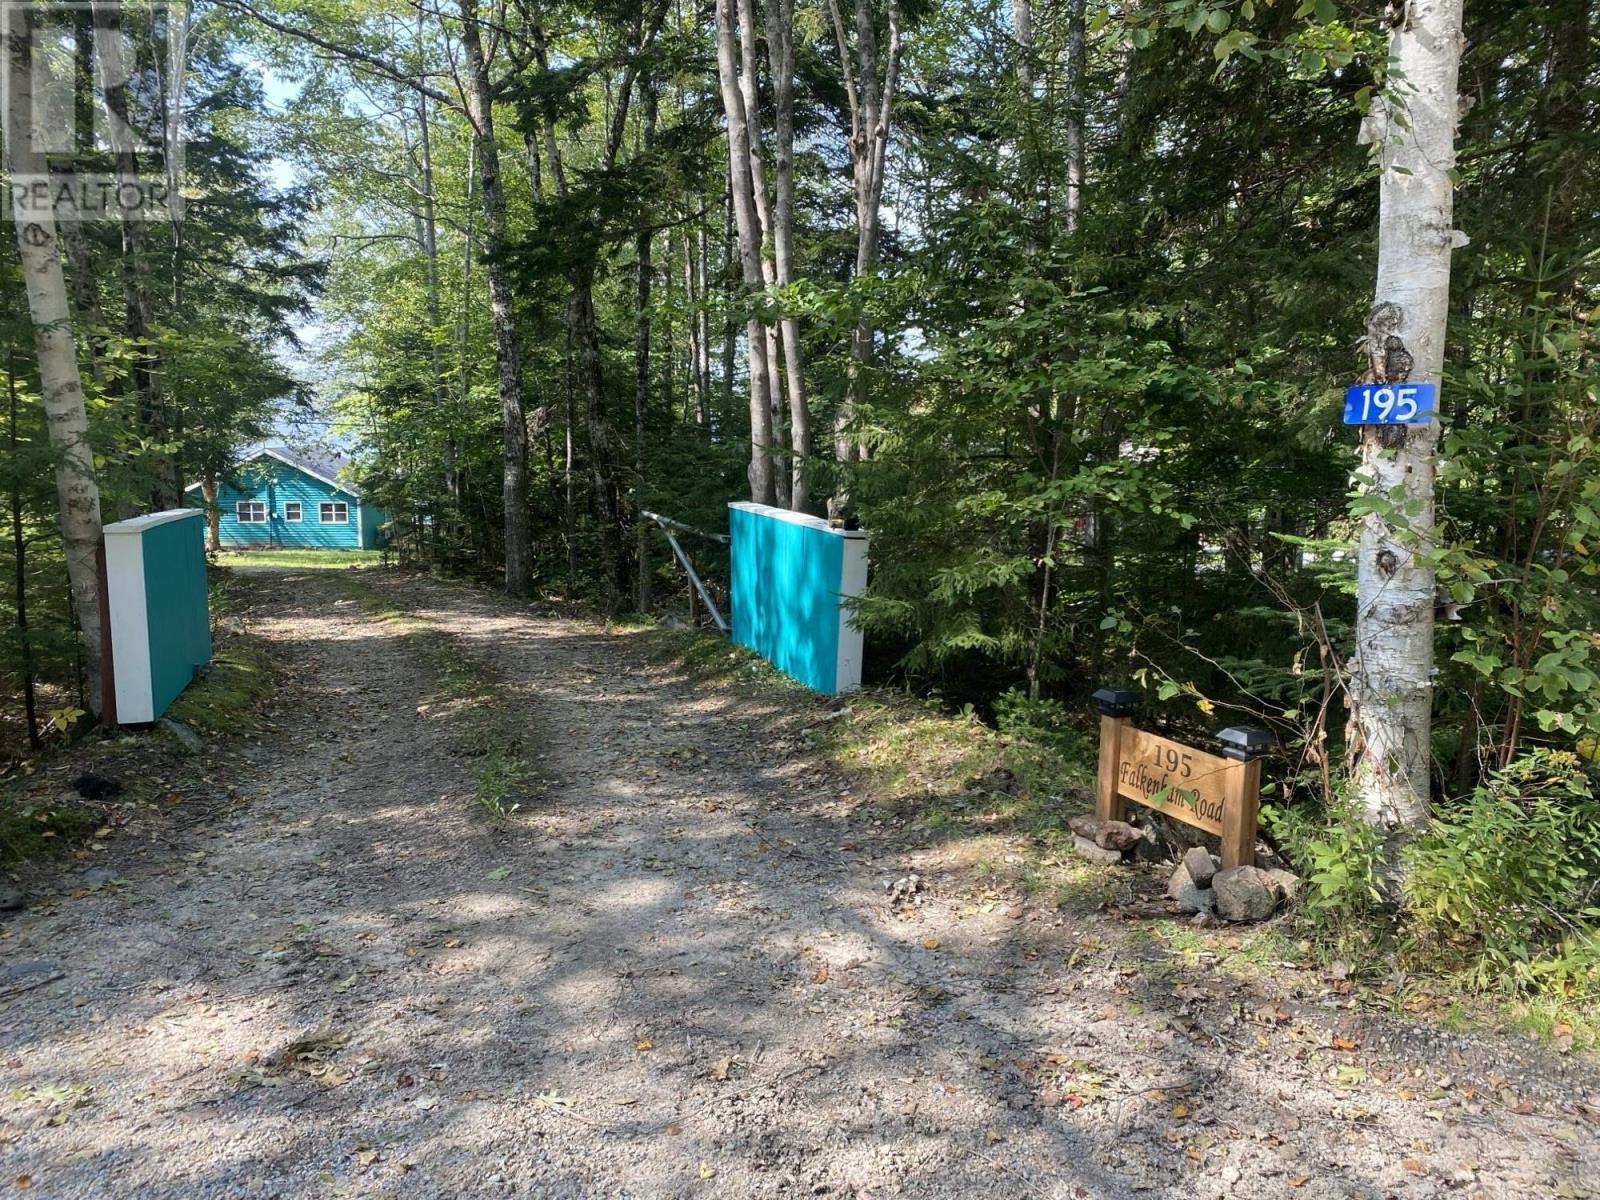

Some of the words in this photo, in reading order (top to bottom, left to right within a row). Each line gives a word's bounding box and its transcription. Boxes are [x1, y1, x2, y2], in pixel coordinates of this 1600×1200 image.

[1362, 388, 1418, 421] 195
[1154, 744, 1193, 778] 195
[1190, 788, 1226, 822] Road
